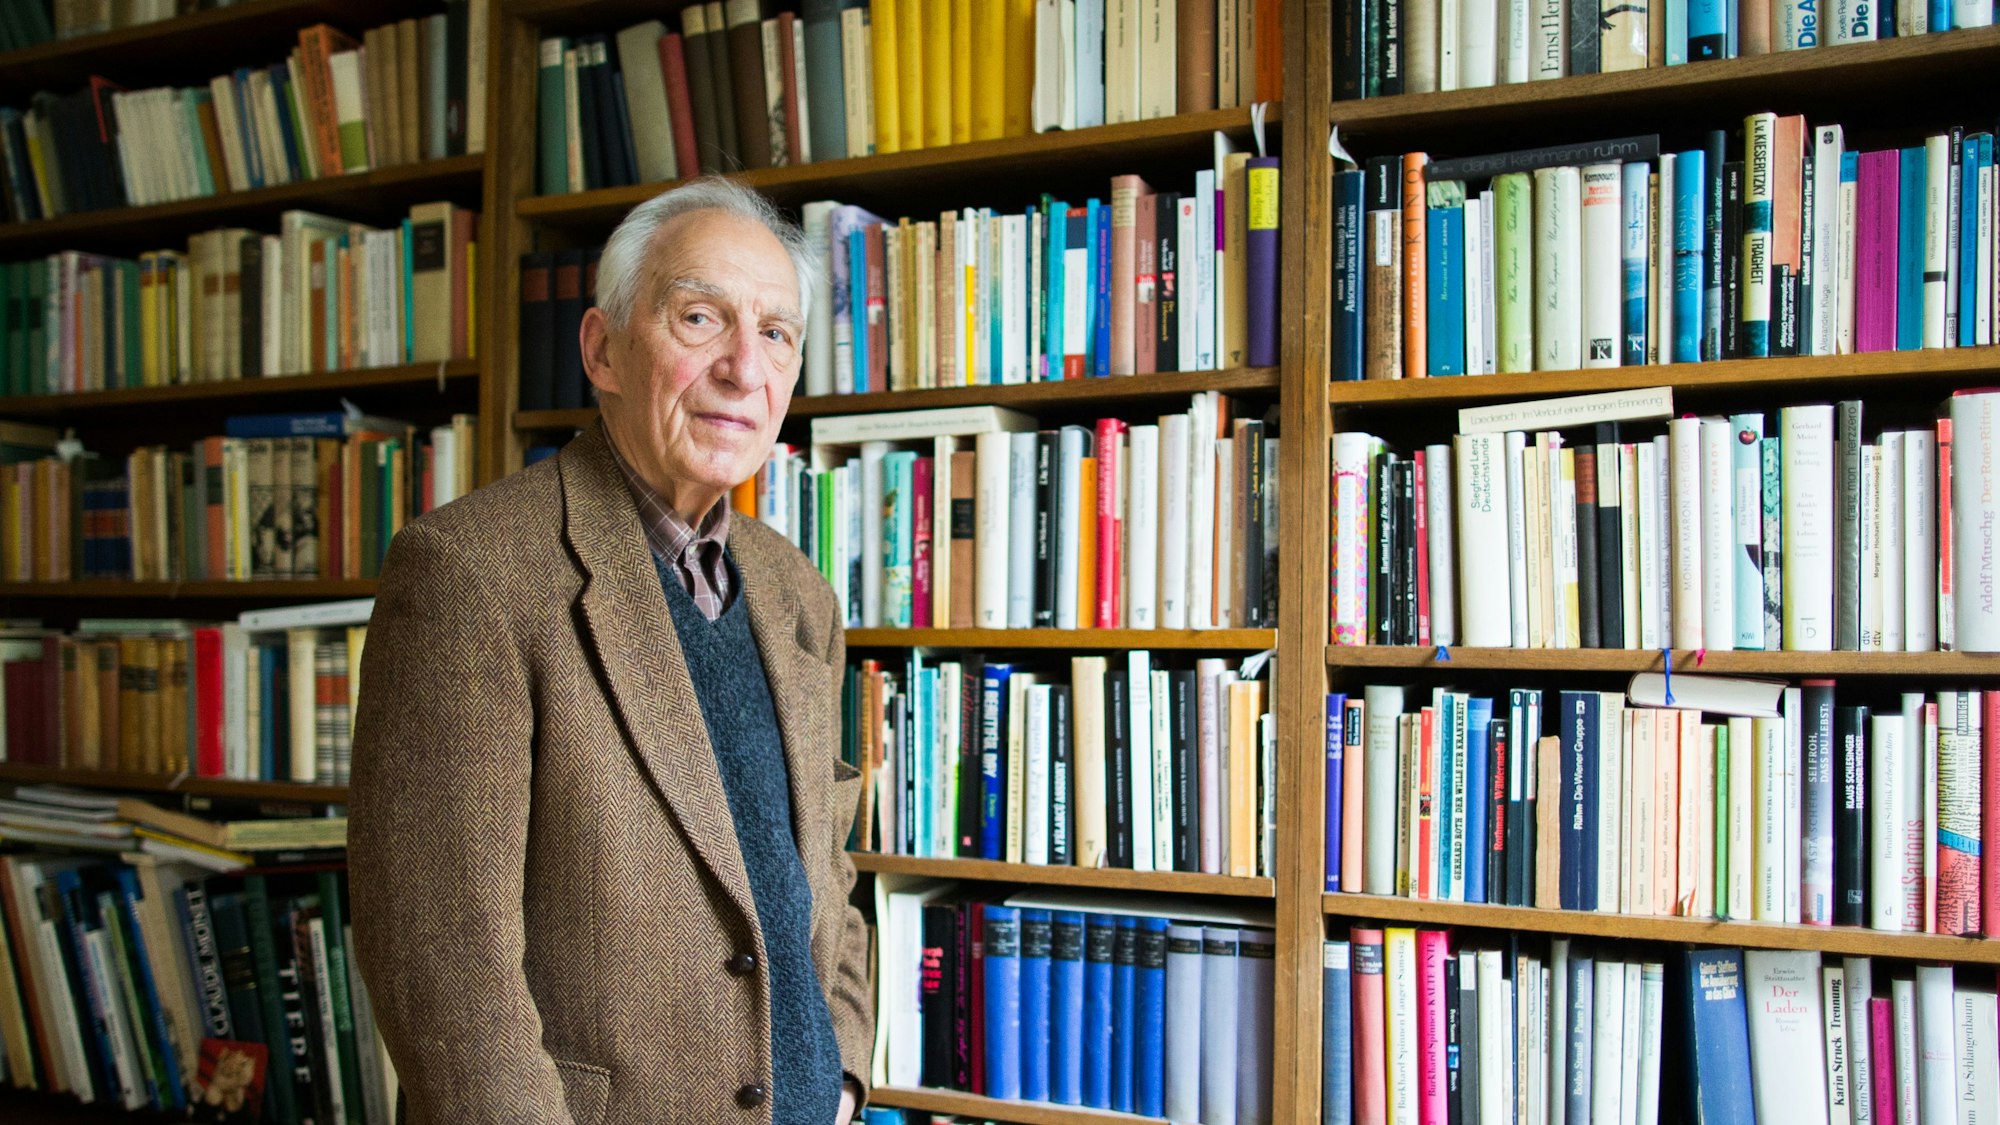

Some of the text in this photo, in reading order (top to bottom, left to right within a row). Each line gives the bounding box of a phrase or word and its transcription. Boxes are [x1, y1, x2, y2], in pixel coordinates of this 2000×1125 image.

[1798, 16, 1816, 47] Die
[1852, 8, 1868, 37] Die
[1461, 157, 1508, 173] daniel
[1511, 148, 1590, 169] kehlmann
[1593, 140, 1640, 158] ruhm
[1752, 134, 1766, 197] KIESERITZKY
[1406, 169, 1421, 246] KINO
[1345, 273, 1356, 313] ABSCHIED
[1712, 263, 1721, 284] Imre
[1820, 284, 1830, 352] Alexander Kluge
[1470, 438, 1483, 509] Siegfried Lenz
[1481, 438, 1492, 513] Deutschstunde
[1845, 406, 1856, 522] franz mon herzzero
[1681, 475, 1692, 496] Ach
[1681, 500, 1692, 542] MARON
[1863, 506, 1871, 521] Eine
[1873, 464, 1881, 578] Morgner: Hochzeit in Konstantinopel
[1979, 399, 1995, 615] Adolf Muschg Der Rote Ritter
[1681, 546, 1692, 592] MONIKA
[1862, 630, 1871, 646] dtv
[1872, 630, 1881, 647] dtv
[1574, 719, 1587, 752] Gruppe
[1957, 696, 1967, 736] PAARUNGEN
[983, 753, 998, 779] DAY
[1808, 731, 1818, 783] SEI FROH,
[1820, 739, 1830, 755] DU
[1574, 752, 1585, 785] Wiener
[1820, 756, 1830, 783] DASS
[1846, 734, 1855, 809] KLAUS SCHLESINGER
[1453, 701, 1464, 881] GERHARD ROTH DER WILLE ZUR KRANKHEIT
[1574, 785, 1584, 801] Die
[1884, 788, 1893, 821] Schlink
[1493, 804, 1505, 851] Rothmann
[1808, 789, 1818, 865] ASTA SCHEIB
[1884, 820, 1893, 860] Bernhard
[1901, 819, 1923, 929] Frau Sartoris
[186, 888, 230, 1036] CLAUDE MONET
[1764, 974, 1806, 982] Strittmatter
[1773, 967, 1795, 975] Erwin
[1766, 999, 1808, 1014] Laden
[1773, 984, 1799, 998] Der
[1397, 939, 1408, 1110] Burkhard Spinnen Langer Samstag
[1426, 942, 1438, 1098] Burkhard Spinnen KALTE ENTE
[1574, 969, 1585, 1096] Botho Strauß Paare Passanten
[1902, 1033, 1910, 1046] und
[1960, 998, 1978, 1081] Schlangenbaum
[1829, 979, 1845, 1106] Karin Struck Trennung
[1855, 1058, 1869, 1122] Karin Struck
[1903, 1085, 1912, 1107] Timm
[1962, 1082, 1976, 1102] Der
